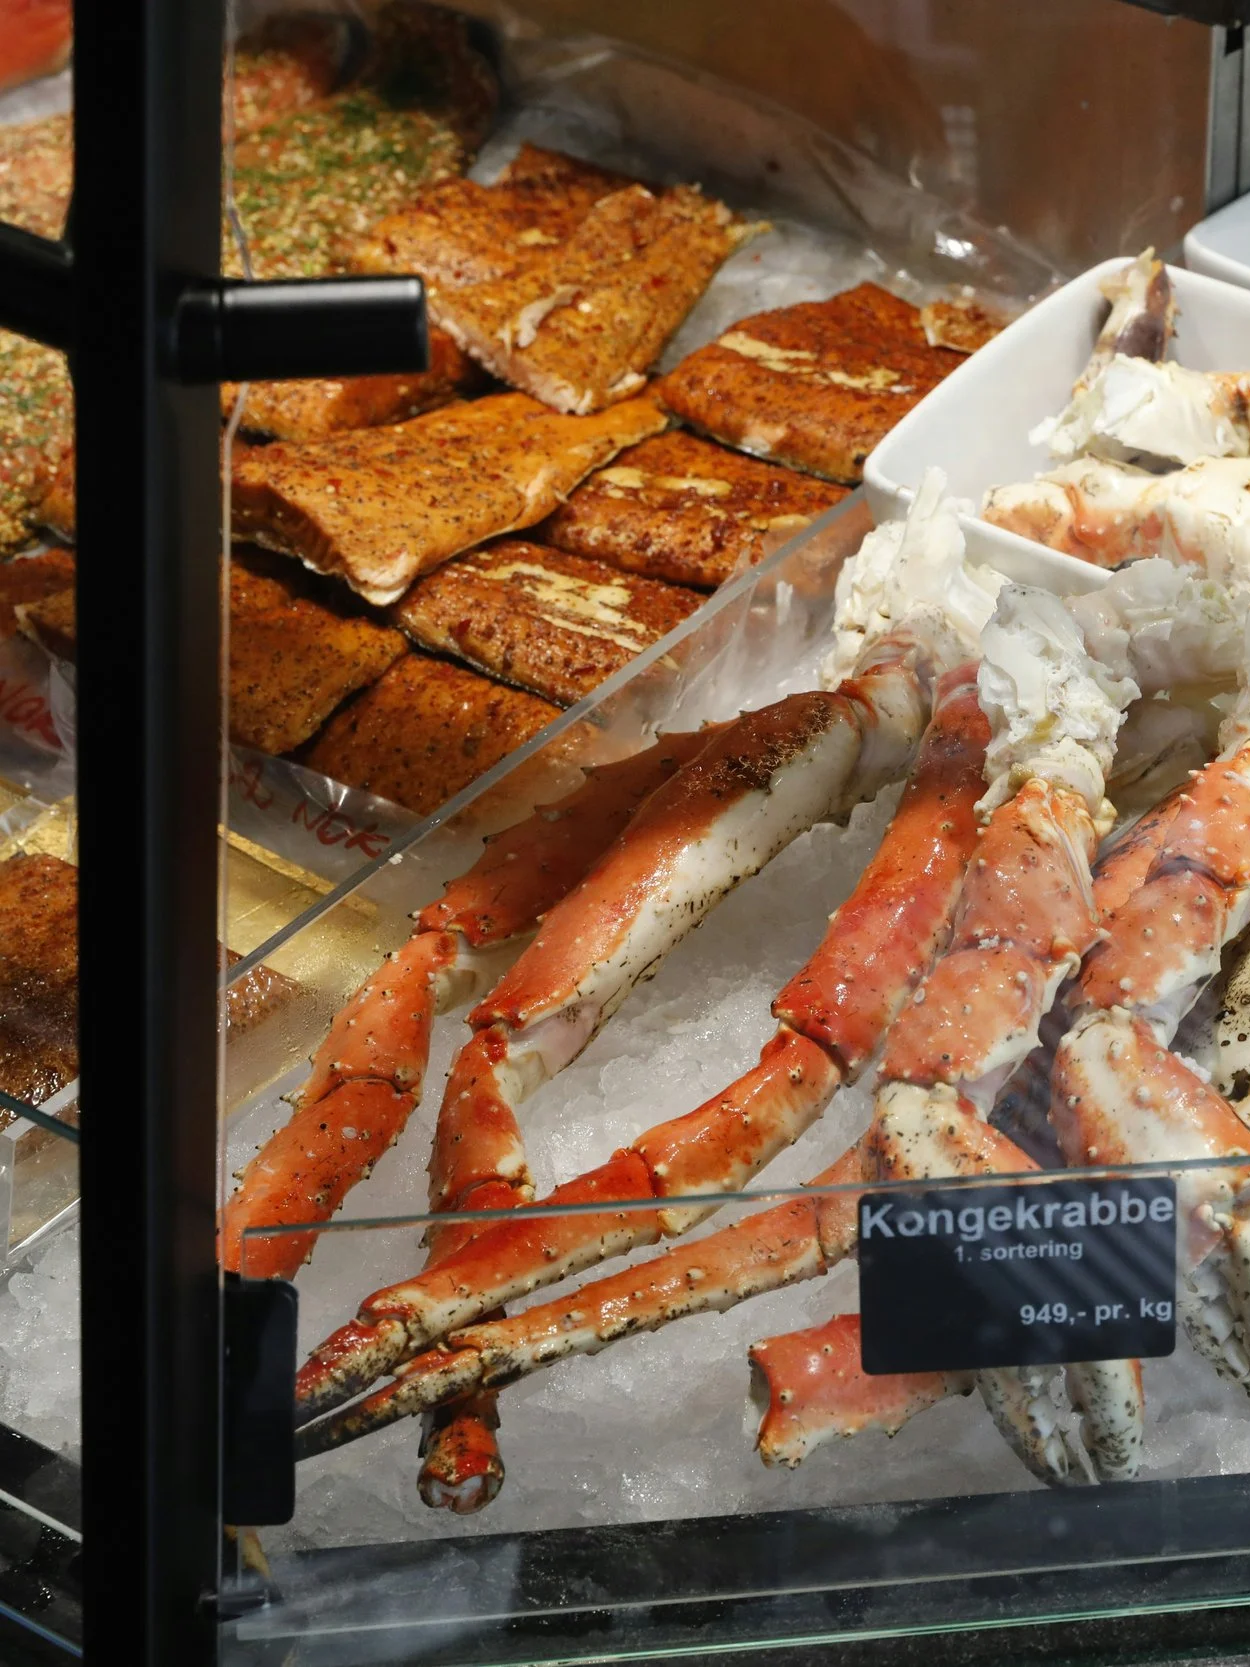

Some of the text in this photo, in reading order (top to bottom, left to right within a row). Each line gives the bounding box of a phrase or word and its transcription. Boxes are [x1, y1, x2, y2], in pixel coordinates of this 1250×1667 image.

[292, 800, 391, 859] NOK
[861, 1190, 1174, 1242] Kongekrabbe
[953, 1240, 1083, 1263] 1. sortering
[1020, 1297, 1173, 1326] 949,- pr. kg
